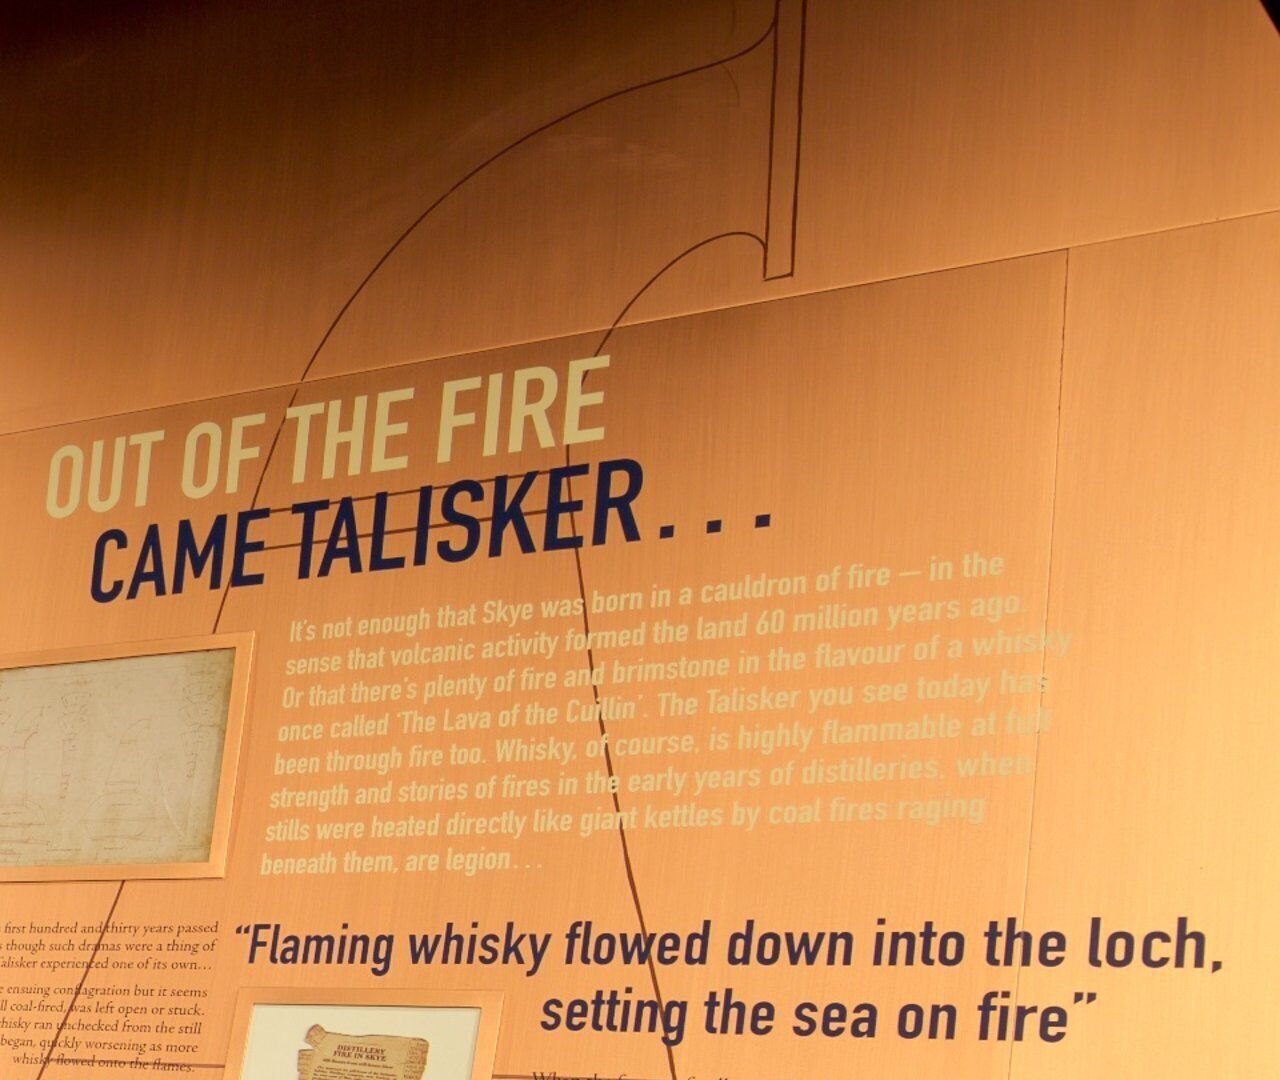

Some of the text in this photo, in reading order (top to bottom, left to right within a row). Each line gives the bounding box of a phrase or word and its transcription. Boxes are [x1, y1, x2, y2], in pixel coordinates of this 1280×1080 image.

[45, 354, 611, 519] OUT OF THE FIRE
[90, 506, 272, 603] CAME
[289, 618, 317, 643] It's
[322, 615, 353, 640] not
[357, 607, 431, 638] enough
[436, 603, 477, 629] that
[482, 599, 534, 628] Skye
[540, 597, 584, 619] was
[591, 589, 643, 614] born
[650, 583, 671, 608] in
[678, 586, 693, 605] a
[700, 572, 807, 604] cauldron
[815, 565, 842, 593] of
[847, 563, 891, 590] fire
[930, 556, 953, 581] in
[963, 552, 1004, 578] the
[4, 921, 28, 934] first
[29, 921, 80, 934] hundred
[80, 921, 104, 934] and
[106, 921, 141, 938] thirty
[142, 924, 174, 938] years
[176, 920, 220, 939] passed
[408, 921, 551, 977] whisky
[565, 920, 712, 966] flowed
[727, 919, 854, 967] down
[872, 918, 965, 967] into
[984, 917, 1067, 968] the
[1088, 917, 1223, 974] loch,
[40, 956, 110, 974] experienced
[111, 960, 136, 970] one
[136, 956, 152, 970] of
[153, 957, 169, 970] its
[540, 987, 688, 1047] setting
[704, 989, 775, 1036] the
[792, 1001, 879, 1039] sea
[896, 1002, 958, 1041] on
